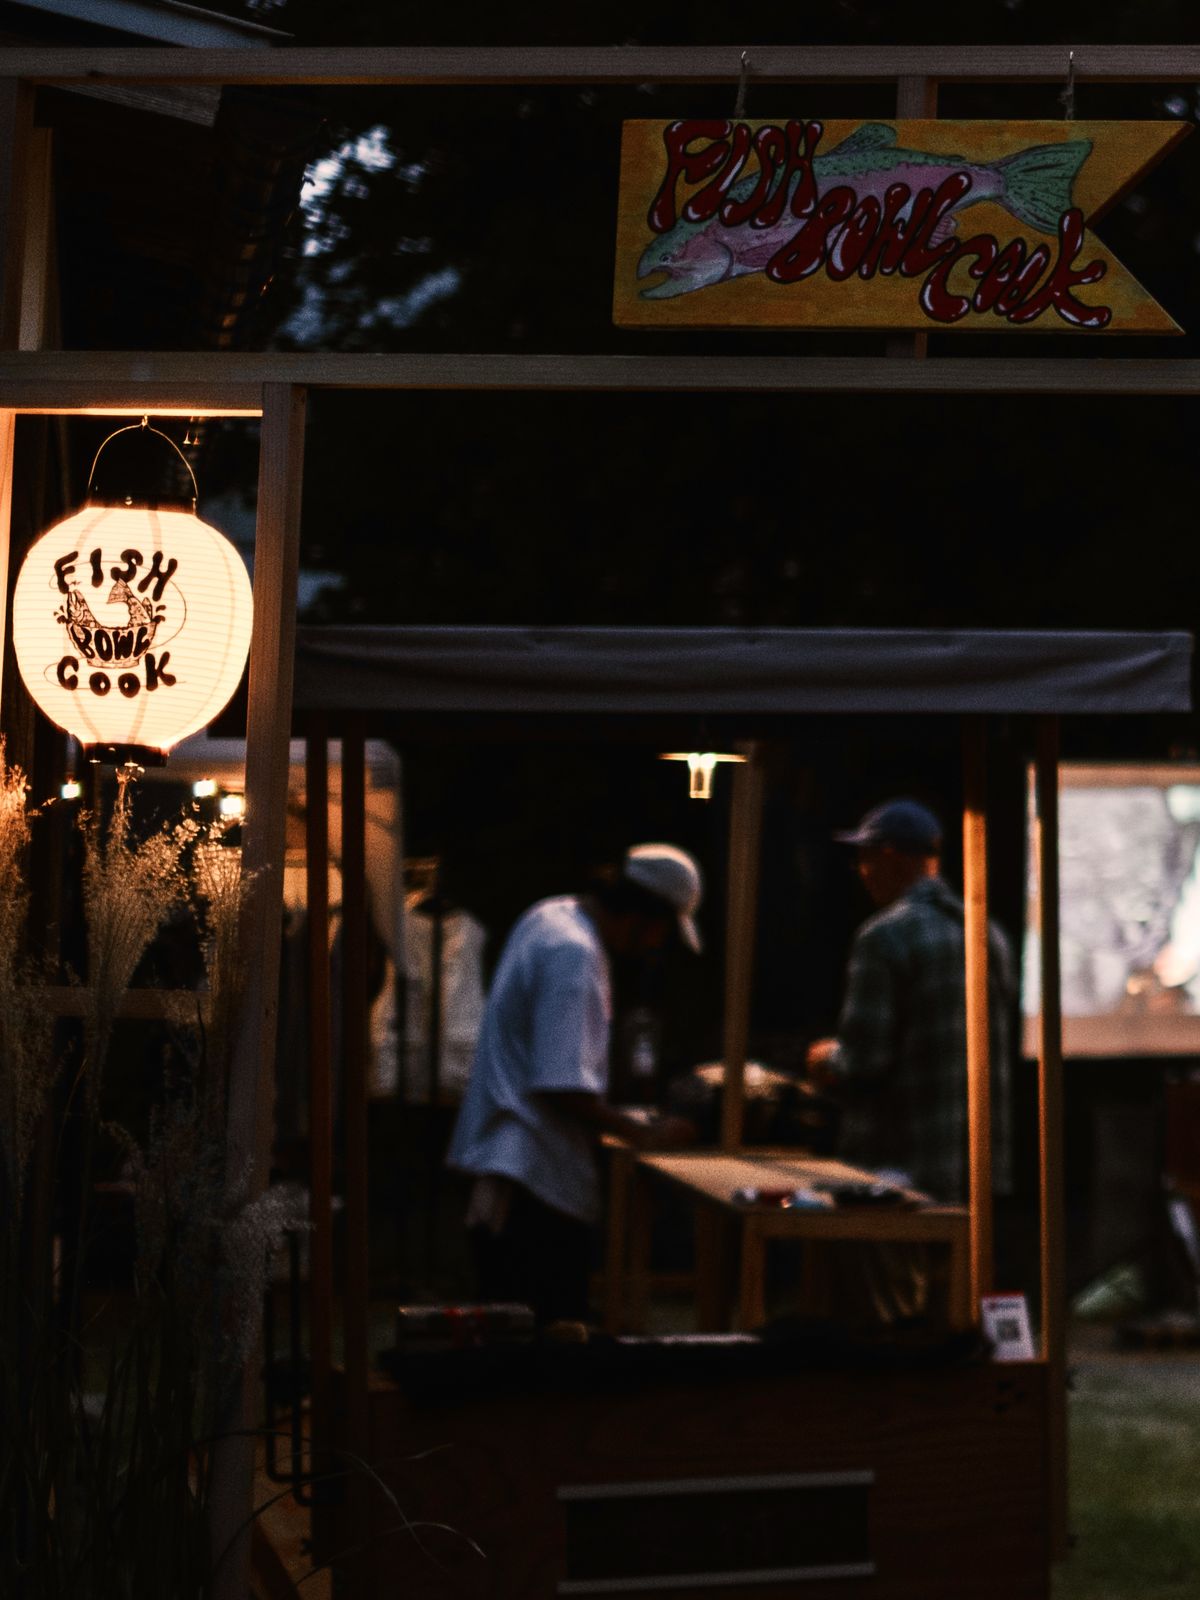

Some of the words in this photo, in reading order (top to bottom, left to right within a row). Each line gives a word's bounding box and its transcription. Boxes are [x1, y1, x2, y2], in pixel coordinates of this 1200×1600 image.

[648, 120, 822, 233] FISH
[766, 171, 972, 283] BOWL
[54, 548, 178, 601] FISH
[70, 624, 152, 661] BOWL
[57, 651, 176, 698] COOK
